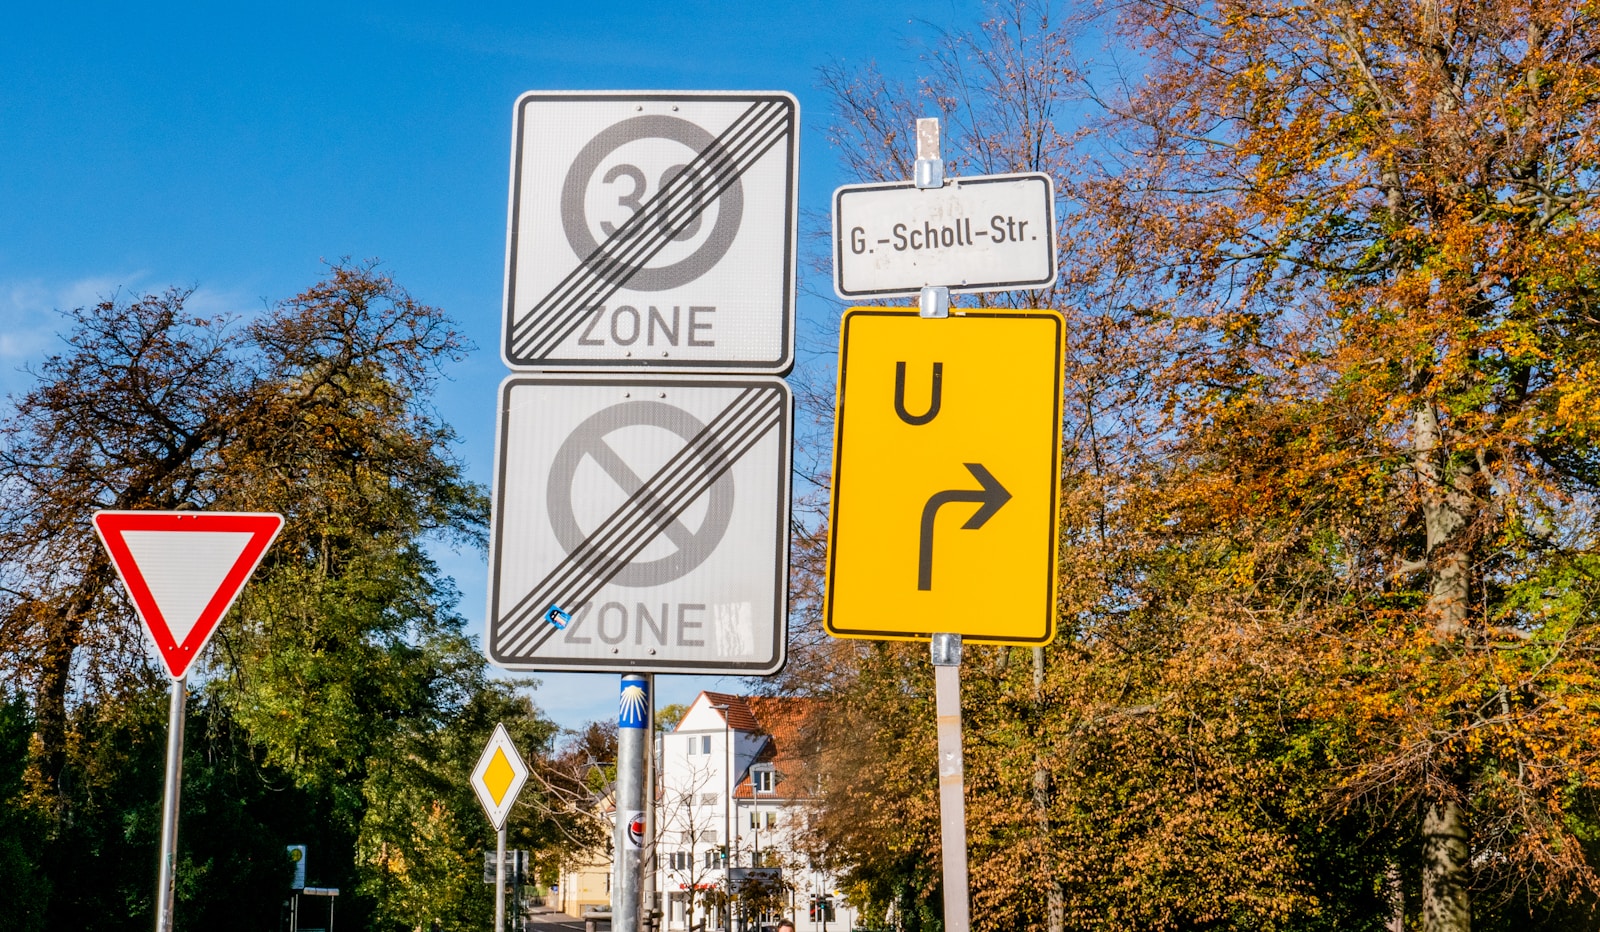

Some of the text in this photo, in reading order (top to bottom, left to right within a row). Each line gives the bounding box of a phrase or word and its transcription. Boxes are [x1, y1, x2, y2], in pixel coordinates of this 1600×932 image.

[600, 164, 703, 242] 30
[850, 215, 1037, 255] G.-Scholl-Str.
[578, 305, 716, 347] ZONE
[894, 361, 943, 426] U
[564, 601, 706, 647] ZONE
